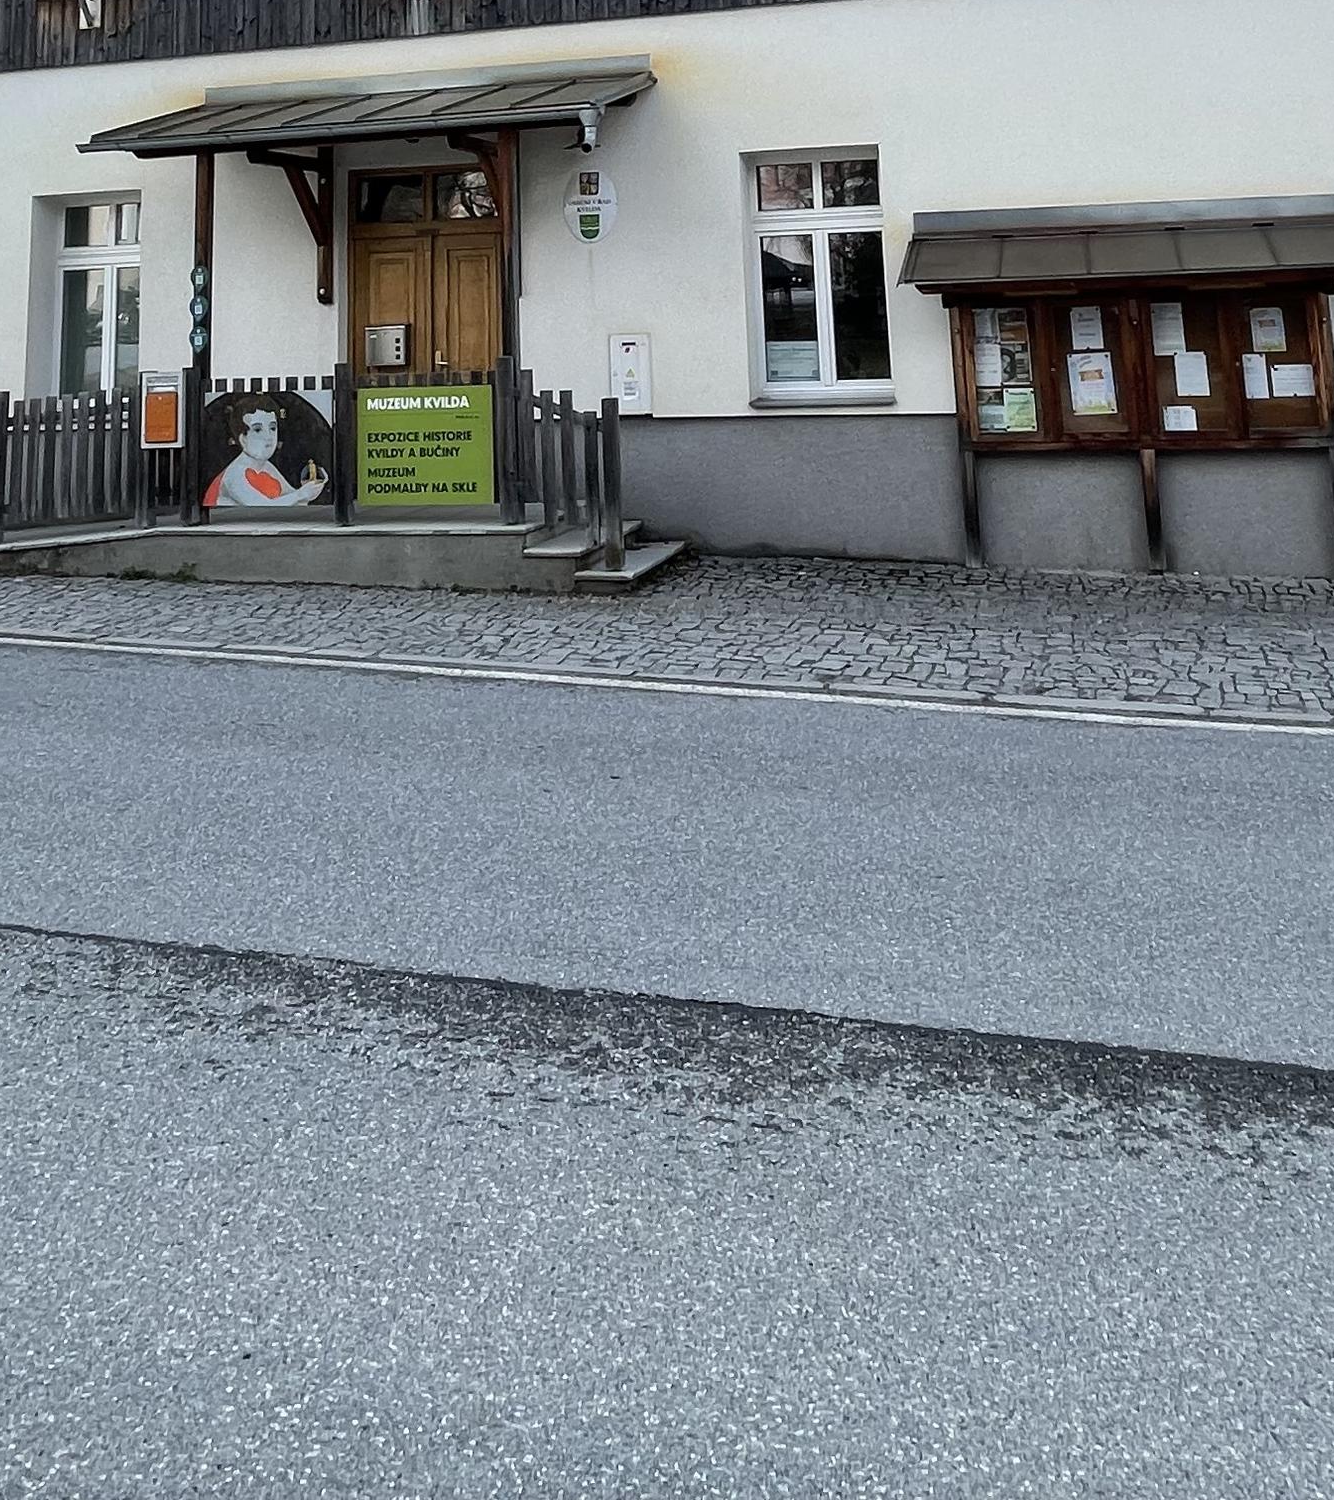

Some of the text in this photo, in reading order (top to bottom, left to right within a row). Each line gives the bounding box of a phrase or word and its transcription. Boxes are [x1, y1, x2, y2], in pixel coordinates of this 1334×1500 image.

[367, 395, 470, 410] MUZEUM KVILDA
[367, 430, 473, 443] EXPOZICE HISTORIE
[367, 445, 461, 459] KVILDY A BUČINY
[367, 467, 416, 478] MUZEUM
[367, 482, 478, 494] PODMALBY NA SKLE
